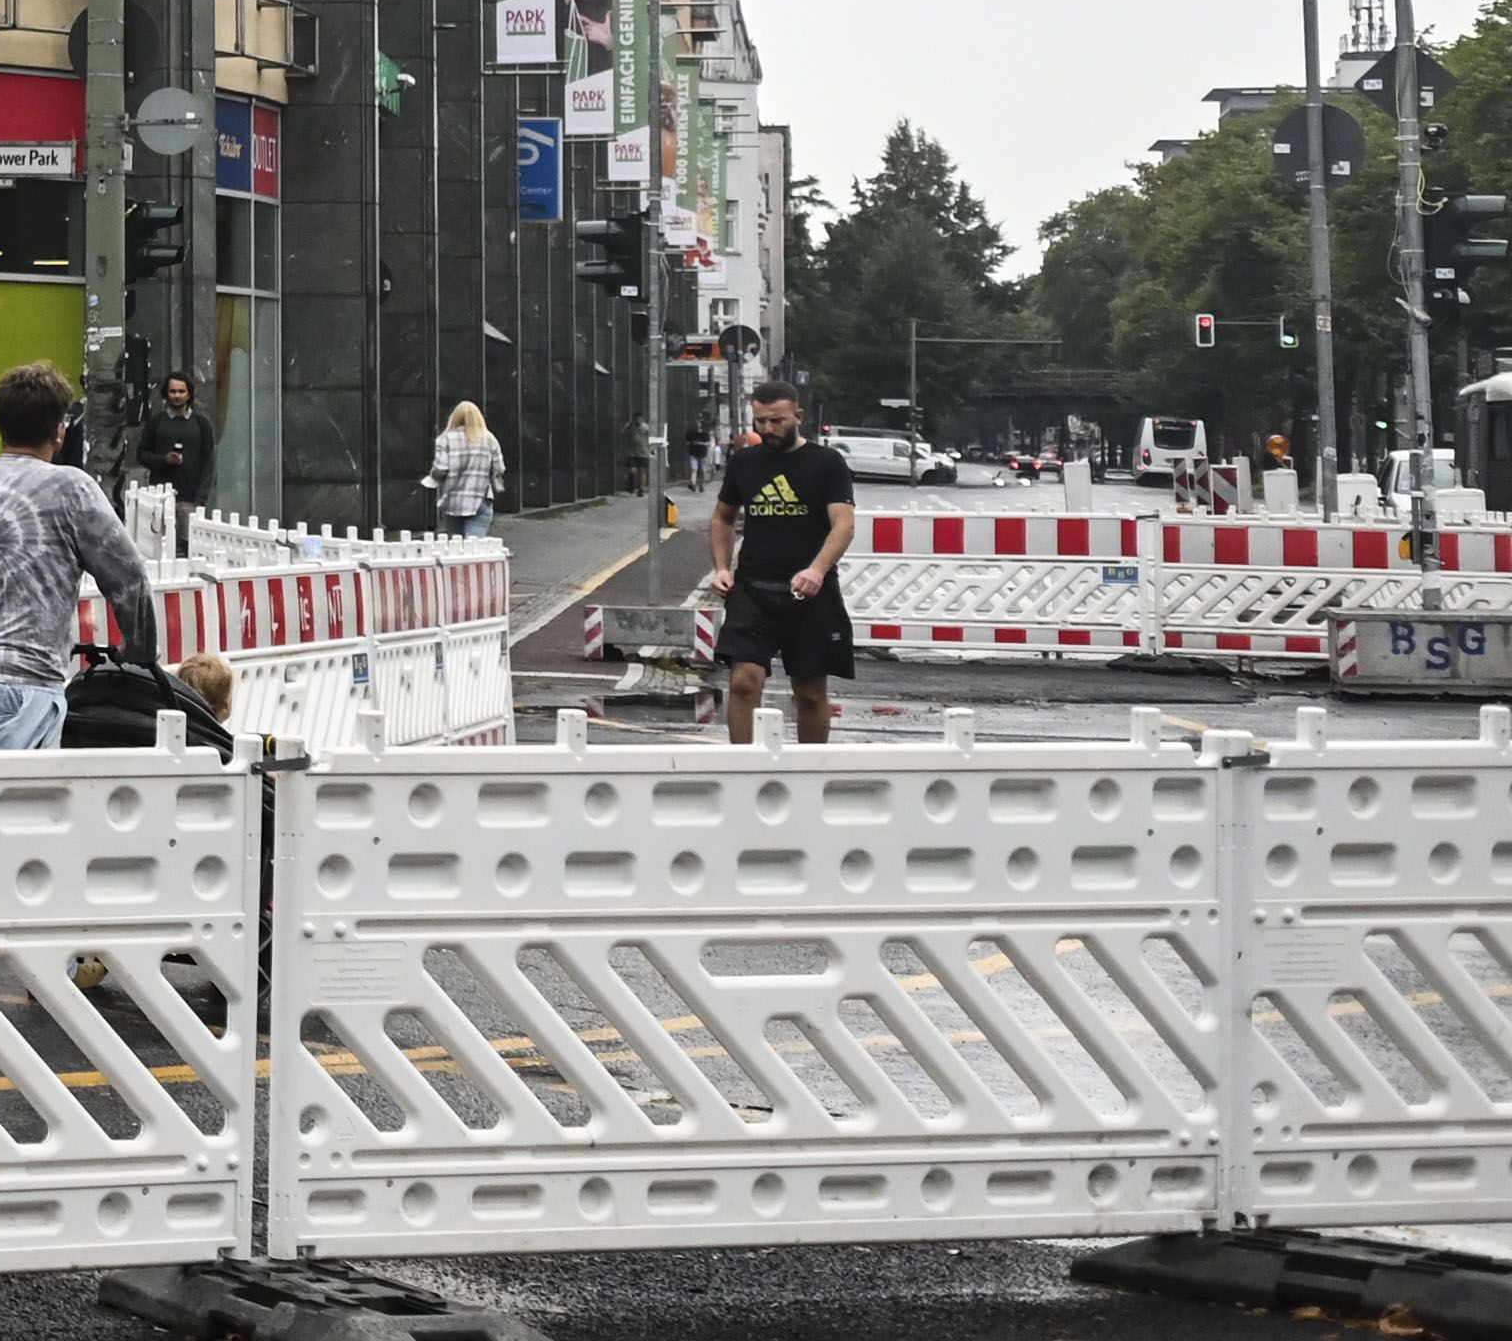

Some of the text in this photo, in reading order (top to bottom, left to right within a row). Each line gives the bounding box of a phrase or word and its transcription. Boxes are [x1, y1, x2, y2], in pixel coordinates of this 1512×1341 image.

[506, 9, 545, 24] PARK
[620, 51, 636, 124] EINFACH
[29, 149, 60, 167] Park
[253, 133, 277, 173] OUTLET
[749, 500, 809, 516] adidas
